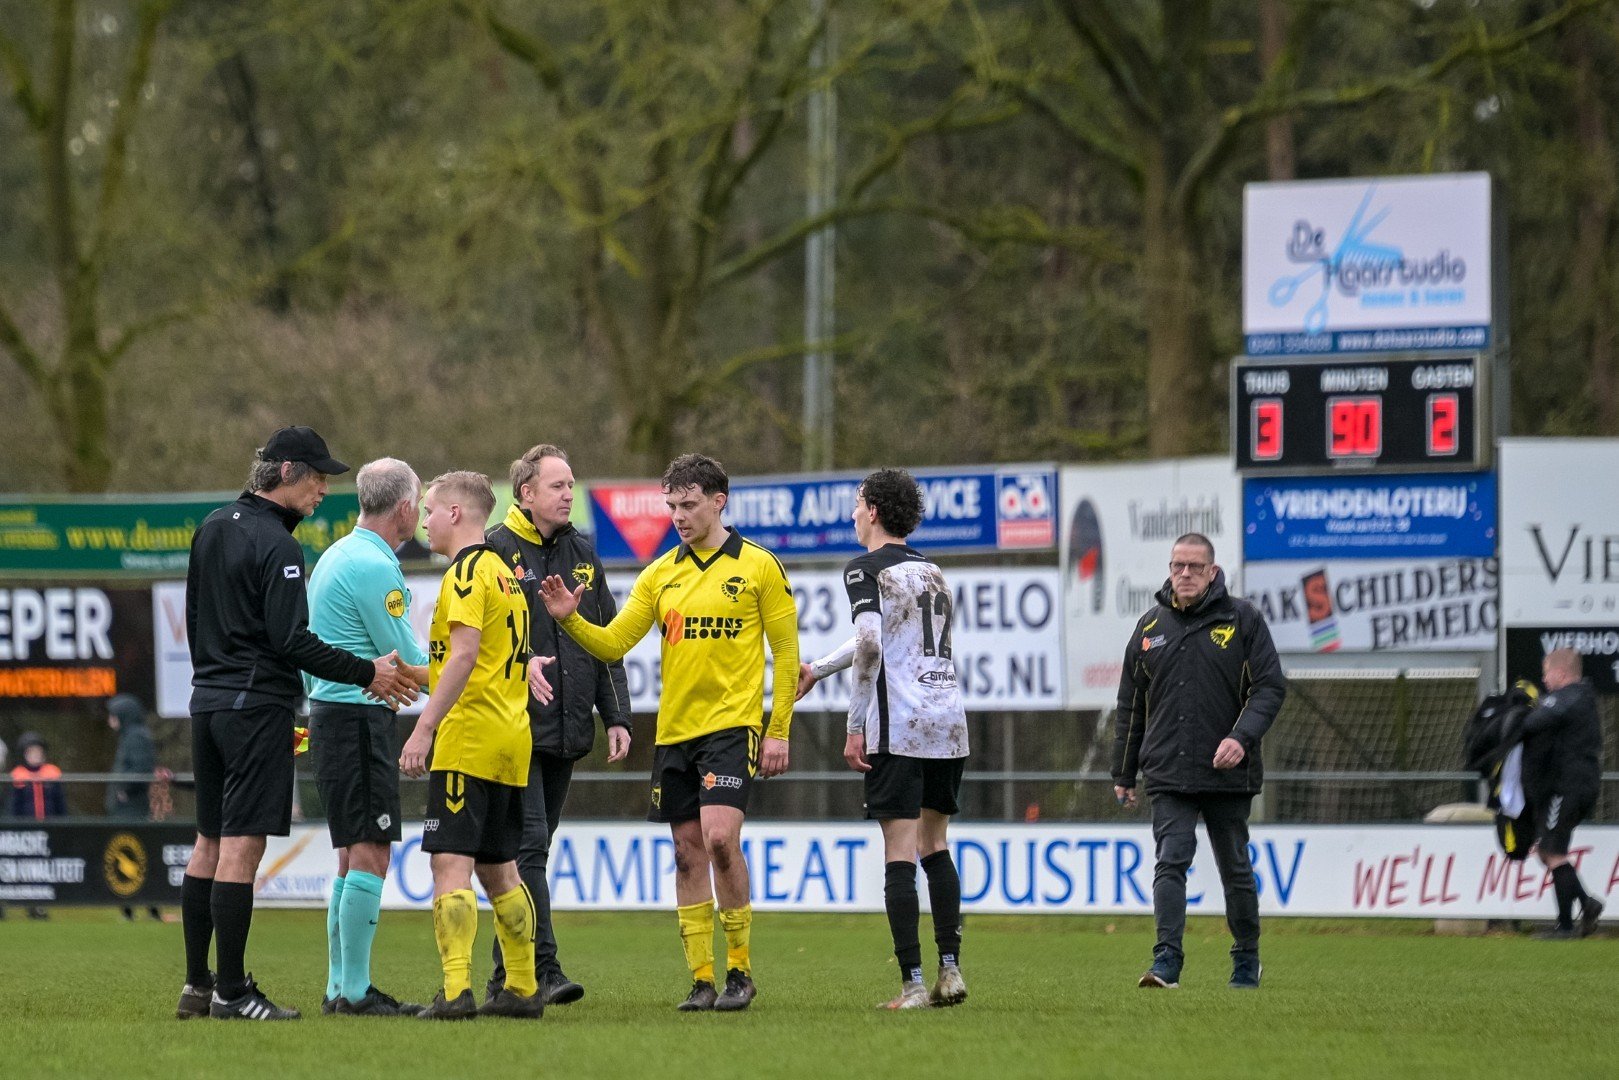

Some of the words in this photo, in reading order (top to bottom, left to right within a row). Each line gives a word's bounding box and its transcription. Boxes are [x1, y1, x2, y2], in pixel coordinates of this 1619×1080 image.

[1287, 219, 1327, 260] De
[1320, 367, 1389, 392] MINUTEN
[1411, 365, 1474, 390] GASTEN
[1255, 401, 1282, 457] 3
[1330, 400, 1380, 455] 90
[1431, 397, 1457, 453] 2
[721, 487, 795, 527] UITER
[1270, 486, 1468, 519] VRIENDENLOTERIJ
[505, 609, 528, 681] 14
[684, 616, 743, 629] PRINS
[684, 628, 741, 640] BOUW
[916, 590, 952, 660] 12
[1371, 600, 1498, 651] ERMELO
[741, 838, 868, 903] EAT
[1353, 845, 1460, 909] WE'LL
